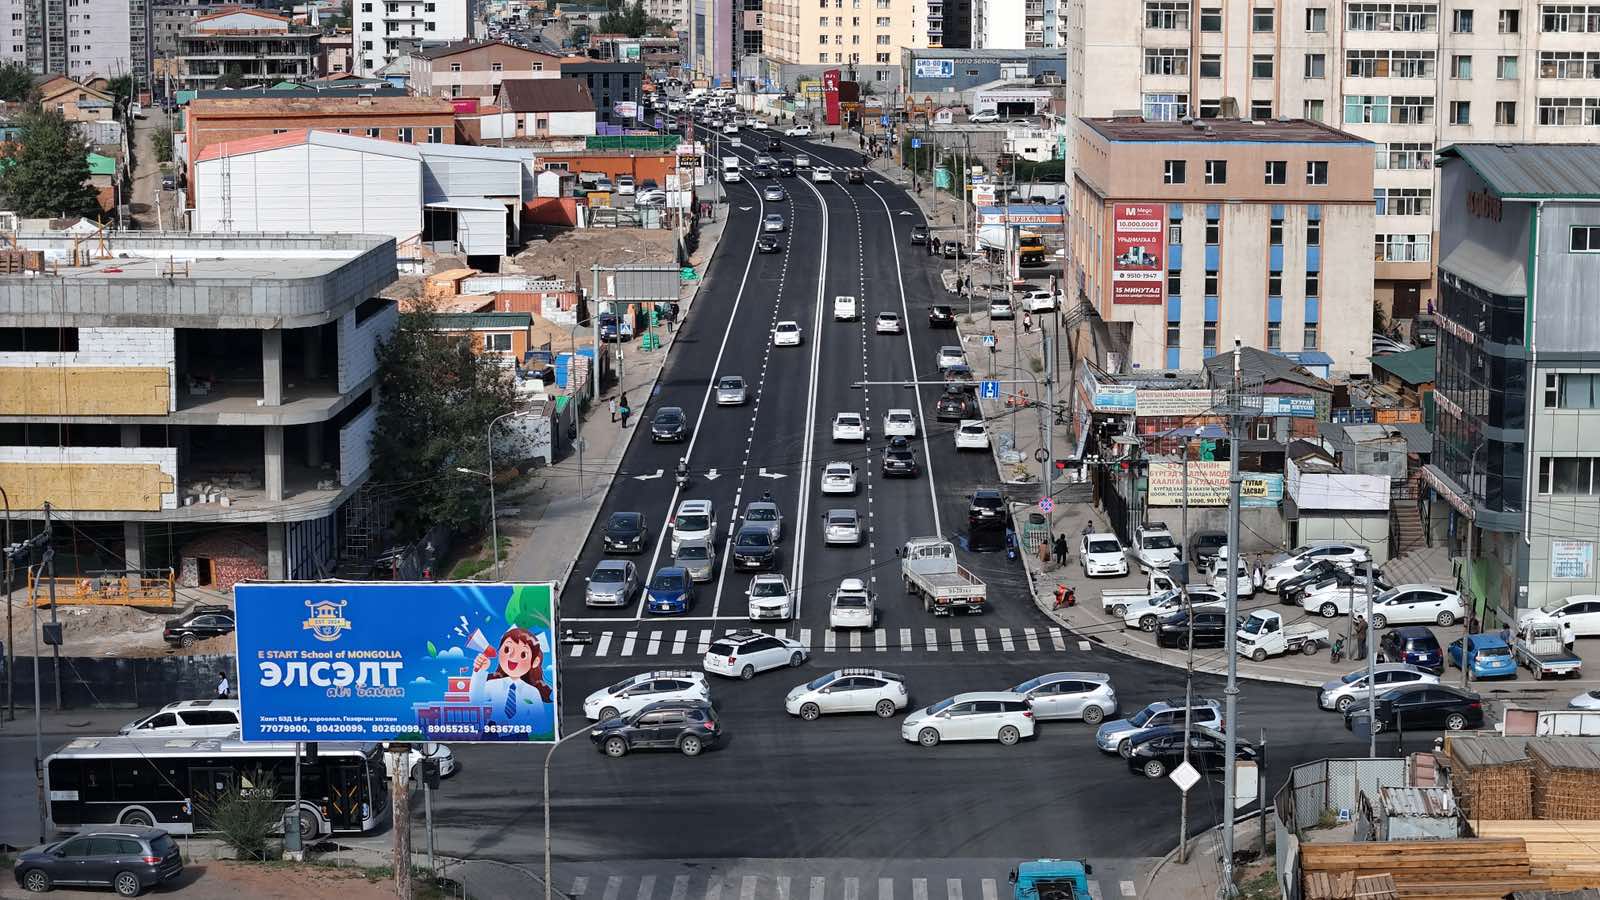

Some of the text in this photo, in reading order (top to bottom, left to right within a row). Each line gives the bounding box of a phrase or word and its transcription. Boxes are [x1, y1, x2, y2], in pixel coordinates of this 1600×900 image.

[257, 650, 402, 659] E START School of MONGOLIA
[258, 661, 404, 687] ЭЛСЭЛТ
[356, 683, 405, 698] байна
[260, 724, 532, 734] 77079900, 80420099, 80260099, 89055251, 96367828
